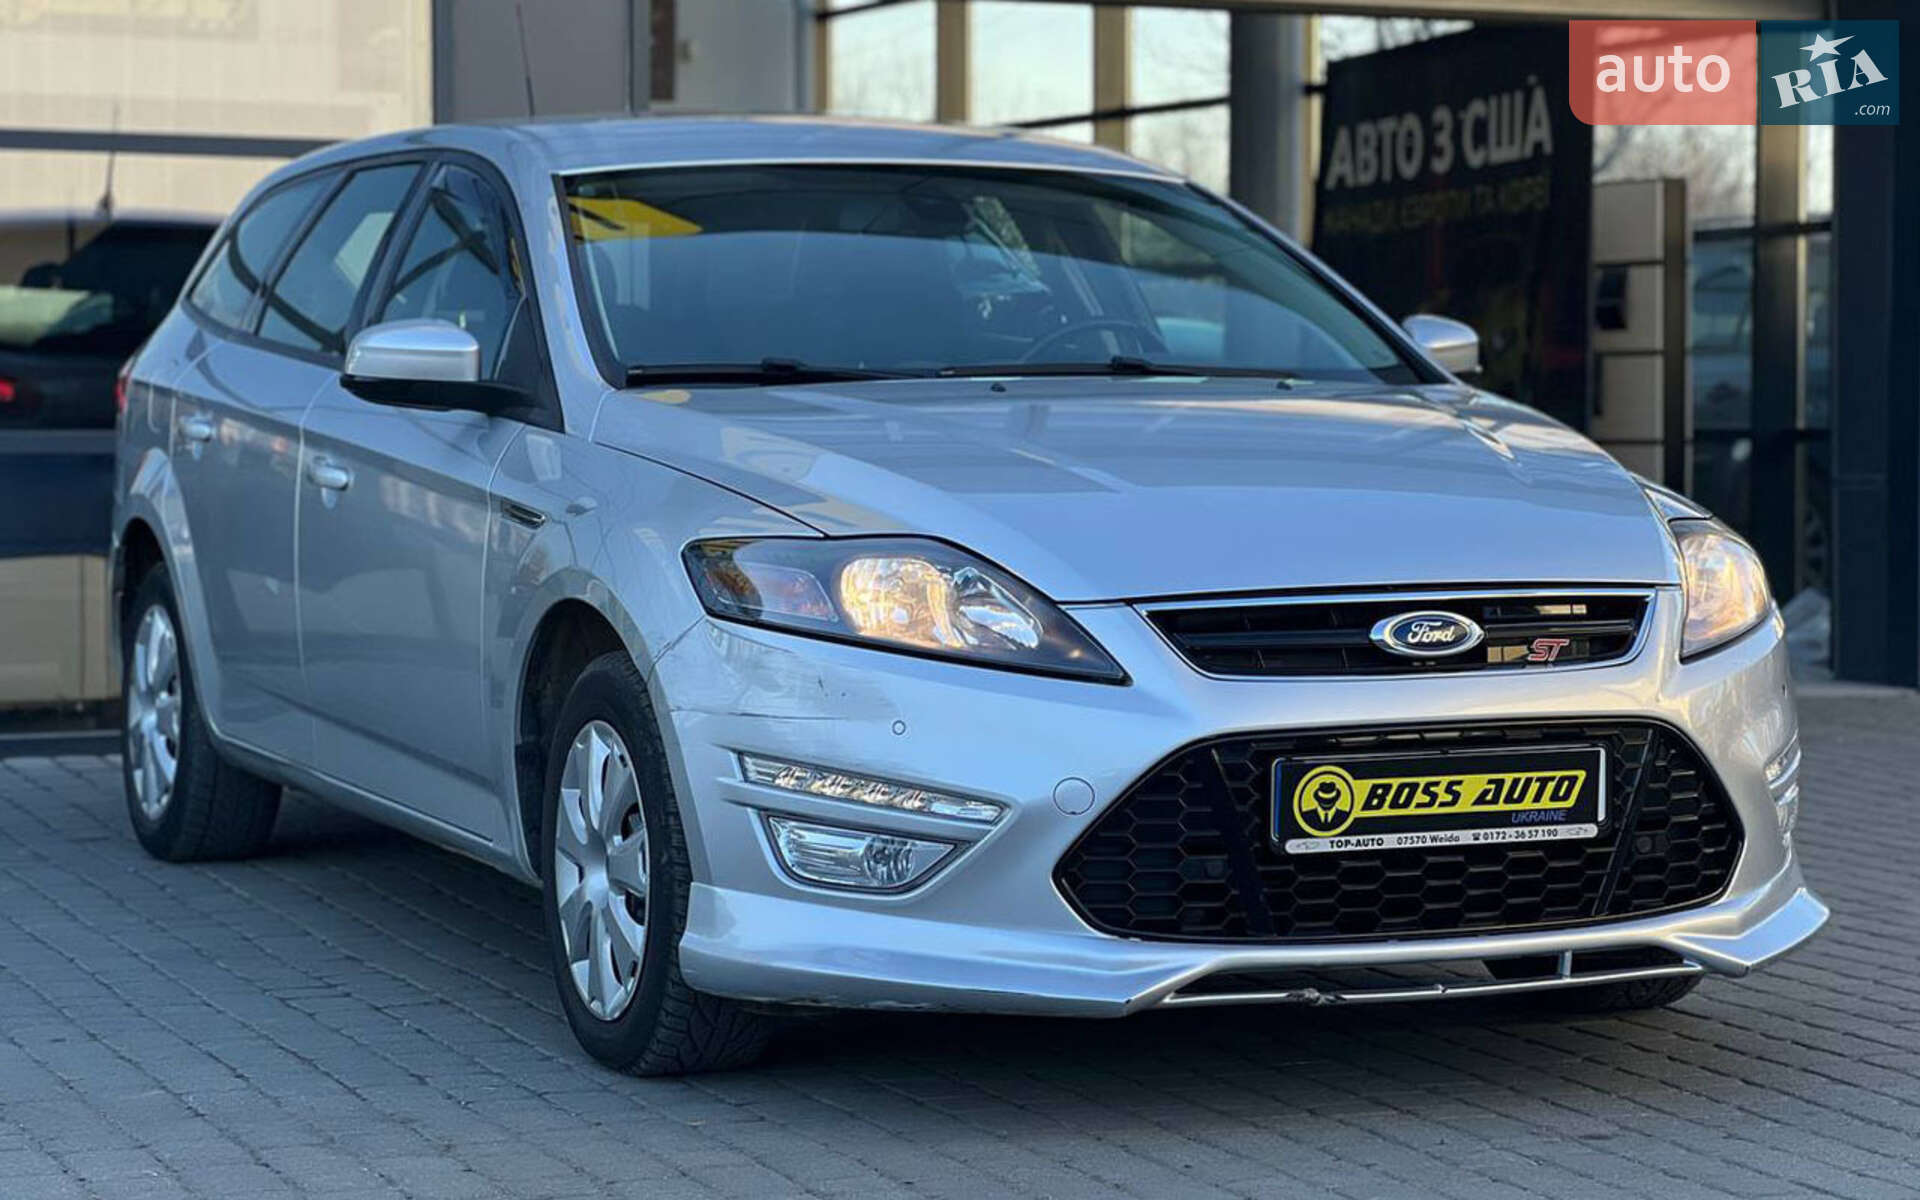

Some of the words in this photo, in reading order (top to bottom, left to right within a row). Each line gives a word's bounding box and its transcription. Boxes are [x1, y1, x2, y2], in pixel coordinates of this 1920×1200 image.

[1324, 111, 1425, 191] АВТО
[1430, 104, 1455, 176] З
[1461, 84, 1554, 170] США
[1407, 620, 1456, 643] Ford
[1527, 638, 1570, 662] ST
[1360, 780, 1464, 812] BOSS
[1471, 774, 1581, 807] AUTO
[1511, 810, 1568, 824] UKRAINE
[1328, 837, 1385, 849] TOP-AUTO
